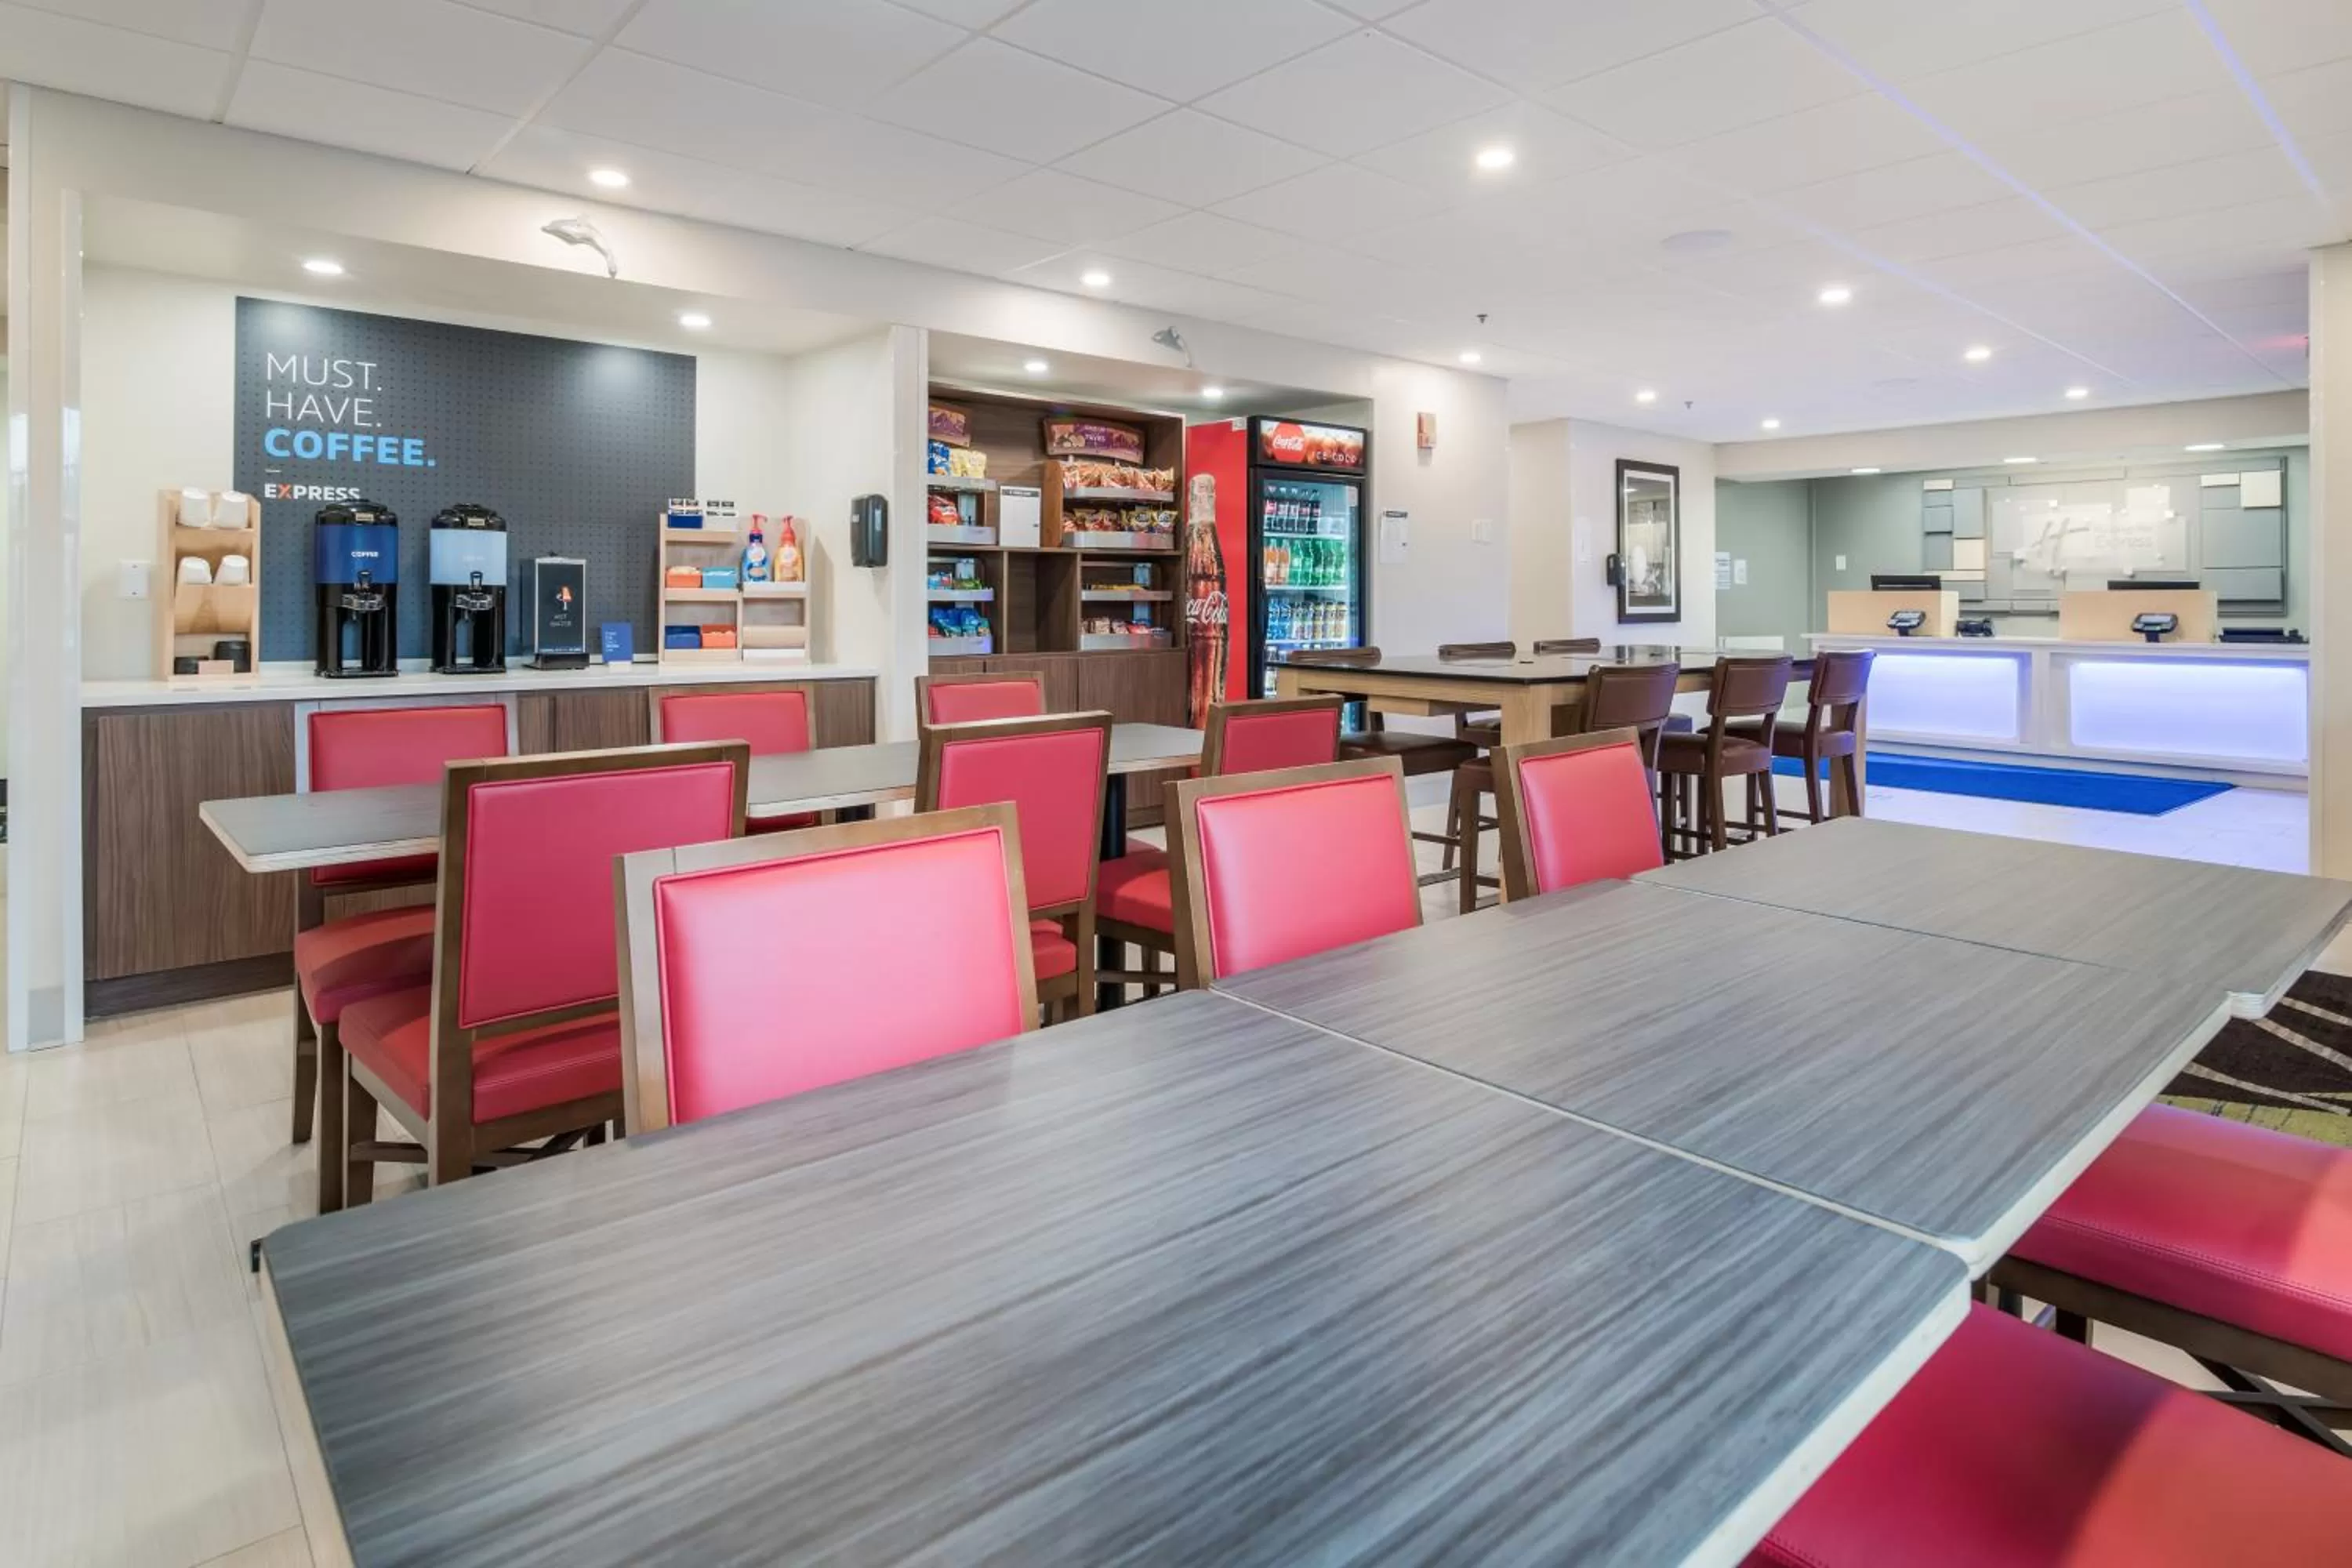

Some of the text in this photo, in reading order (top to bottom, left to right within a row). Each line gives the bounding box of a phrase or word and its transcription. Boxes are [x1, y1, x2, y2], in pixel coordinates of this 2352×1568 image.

[267, 352, 383, 391] MUST.
[267, 390, 382, 427] HAVE.
[264, 427, 436, 467] COFFEE.
[264, 483, 361, 501] EXPRESS
